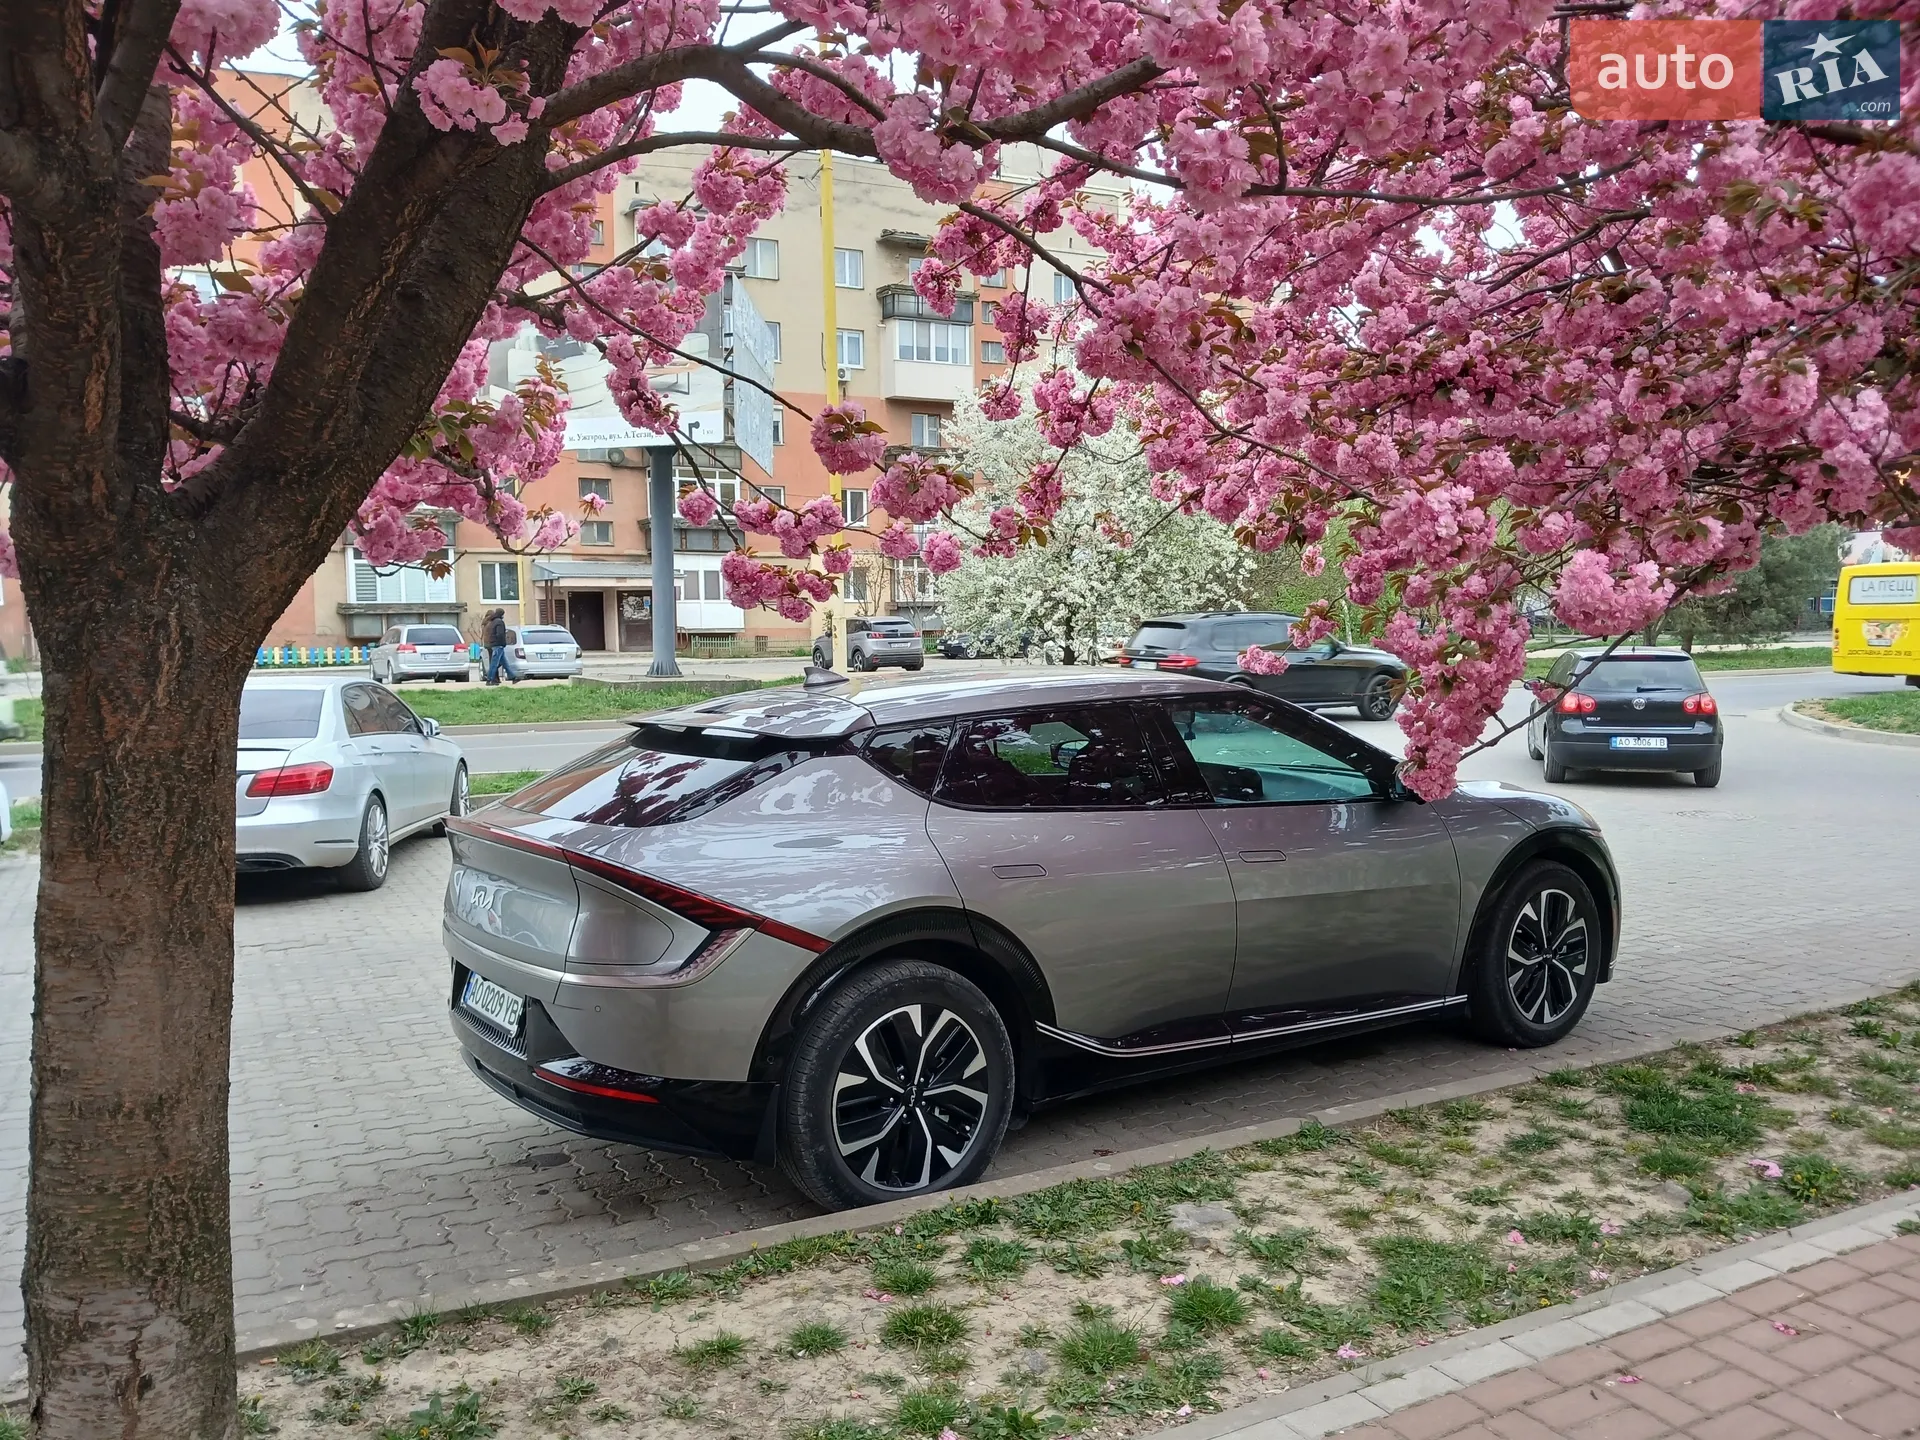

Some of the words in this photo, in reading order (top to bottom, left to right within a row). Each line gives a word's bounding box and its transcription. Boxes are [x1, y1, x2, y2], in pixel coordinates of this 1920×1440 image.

[577, 433, 608, 442] Ужгород,
[1617, 738, 1630, 746] AO
[1632, 738, 1652, 747] 3006
[1655, 738, 1666, 747] IB
[469, 977, 484, 1005] AO
[481, 984, 505, 1018] 0209
[502, 996, 519, 1026] YB
